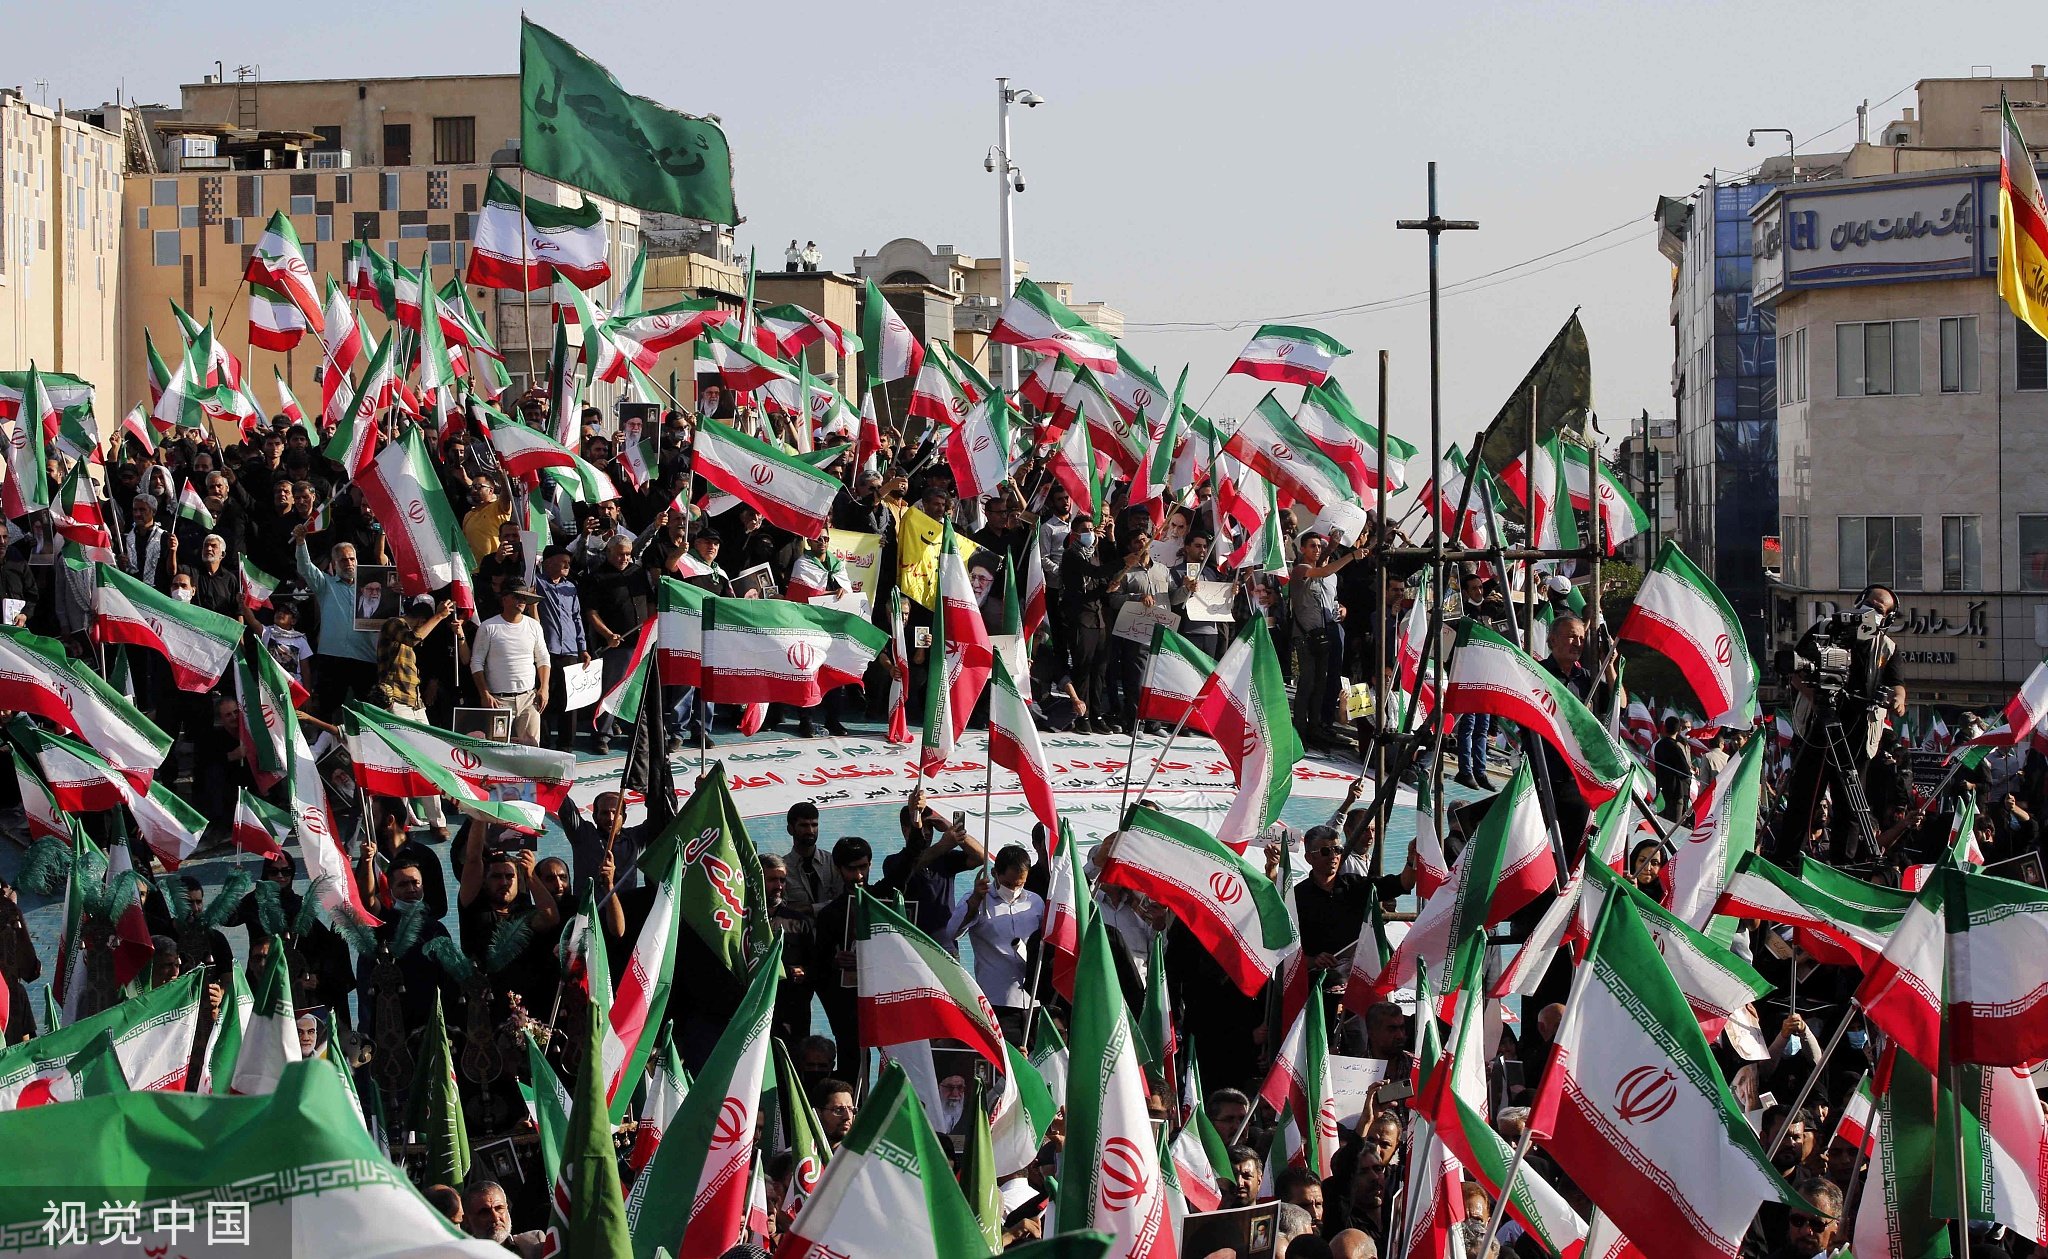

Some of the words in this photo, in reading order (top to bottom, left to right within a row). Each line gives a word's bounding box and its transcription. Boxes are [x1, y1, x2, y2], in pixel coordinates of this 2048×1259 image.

[1870, 210, 1931, 243] صادرات
[1931, 193, 1973, 245] بانک
[1830, 219, 1871, 252] ایران
[1946, 600, 1988, 649] بانک
[1041, 736, 1102, 748] مقد
[727, 745, 803, 763] خیمه
[1069, 758, 1130, 774] خود
[727, 770, 786, 791] اعلا
[805, 789, 851, 804] کشور
[925, 786, 939, 795] و
